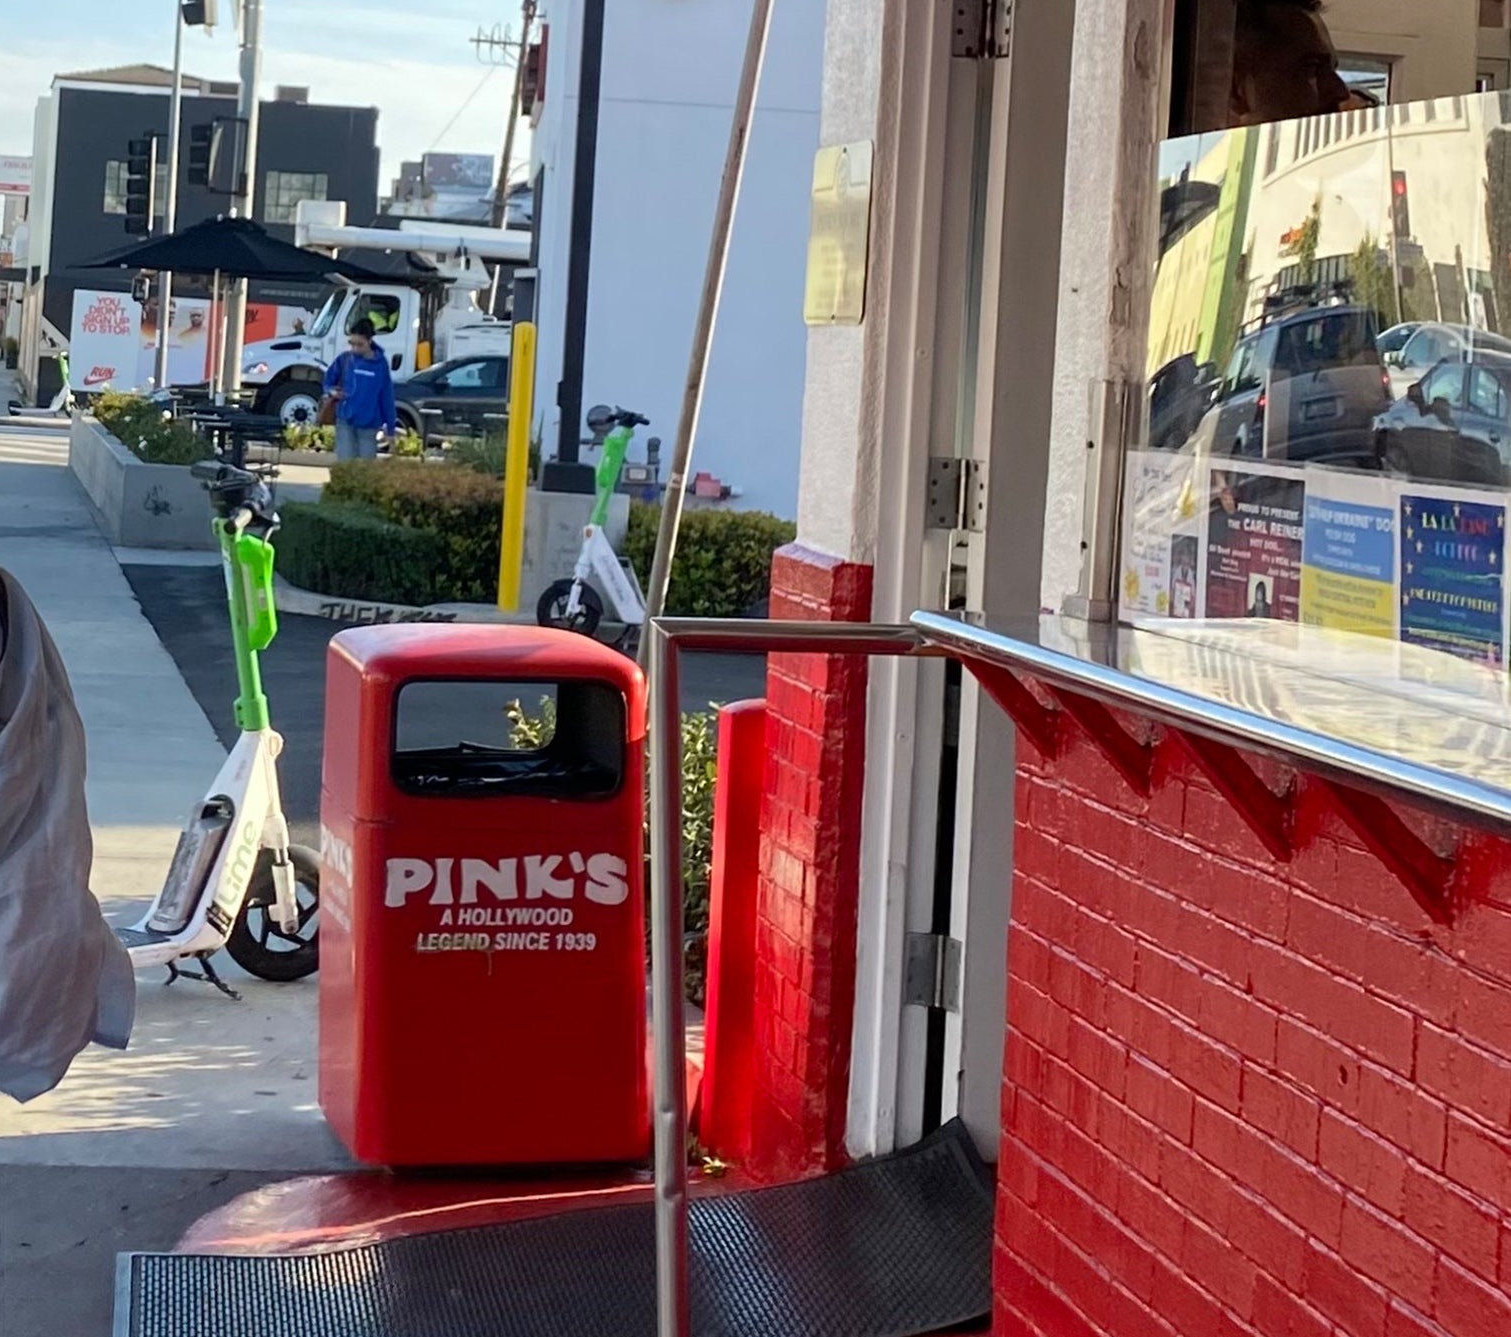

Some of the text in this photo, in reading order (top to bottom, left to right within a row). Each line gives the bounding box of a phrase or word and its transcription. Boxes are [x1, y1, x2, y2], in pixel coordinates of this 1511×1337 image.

[97, 296, 121, 307] YOU
[83, 313, 131, 325] SIGN UP
[89, 305, 127, 317] DIDN'T
[82, 323, 97, 333] TO
[90, 366, 116, 378] RUN
[1243, 518, 1269, 534] CARL
[1270, 522, 1304, 540] REINER
[1421, 512, 1437, 530] LA
[218, 820, 257, 906] Lime
[385, 851, 629, 908] PINK'S
[440, 908, 574, 927] A HOLLYWOOD
[417, 932, 597, 952] LEGEND SINCE 1939
